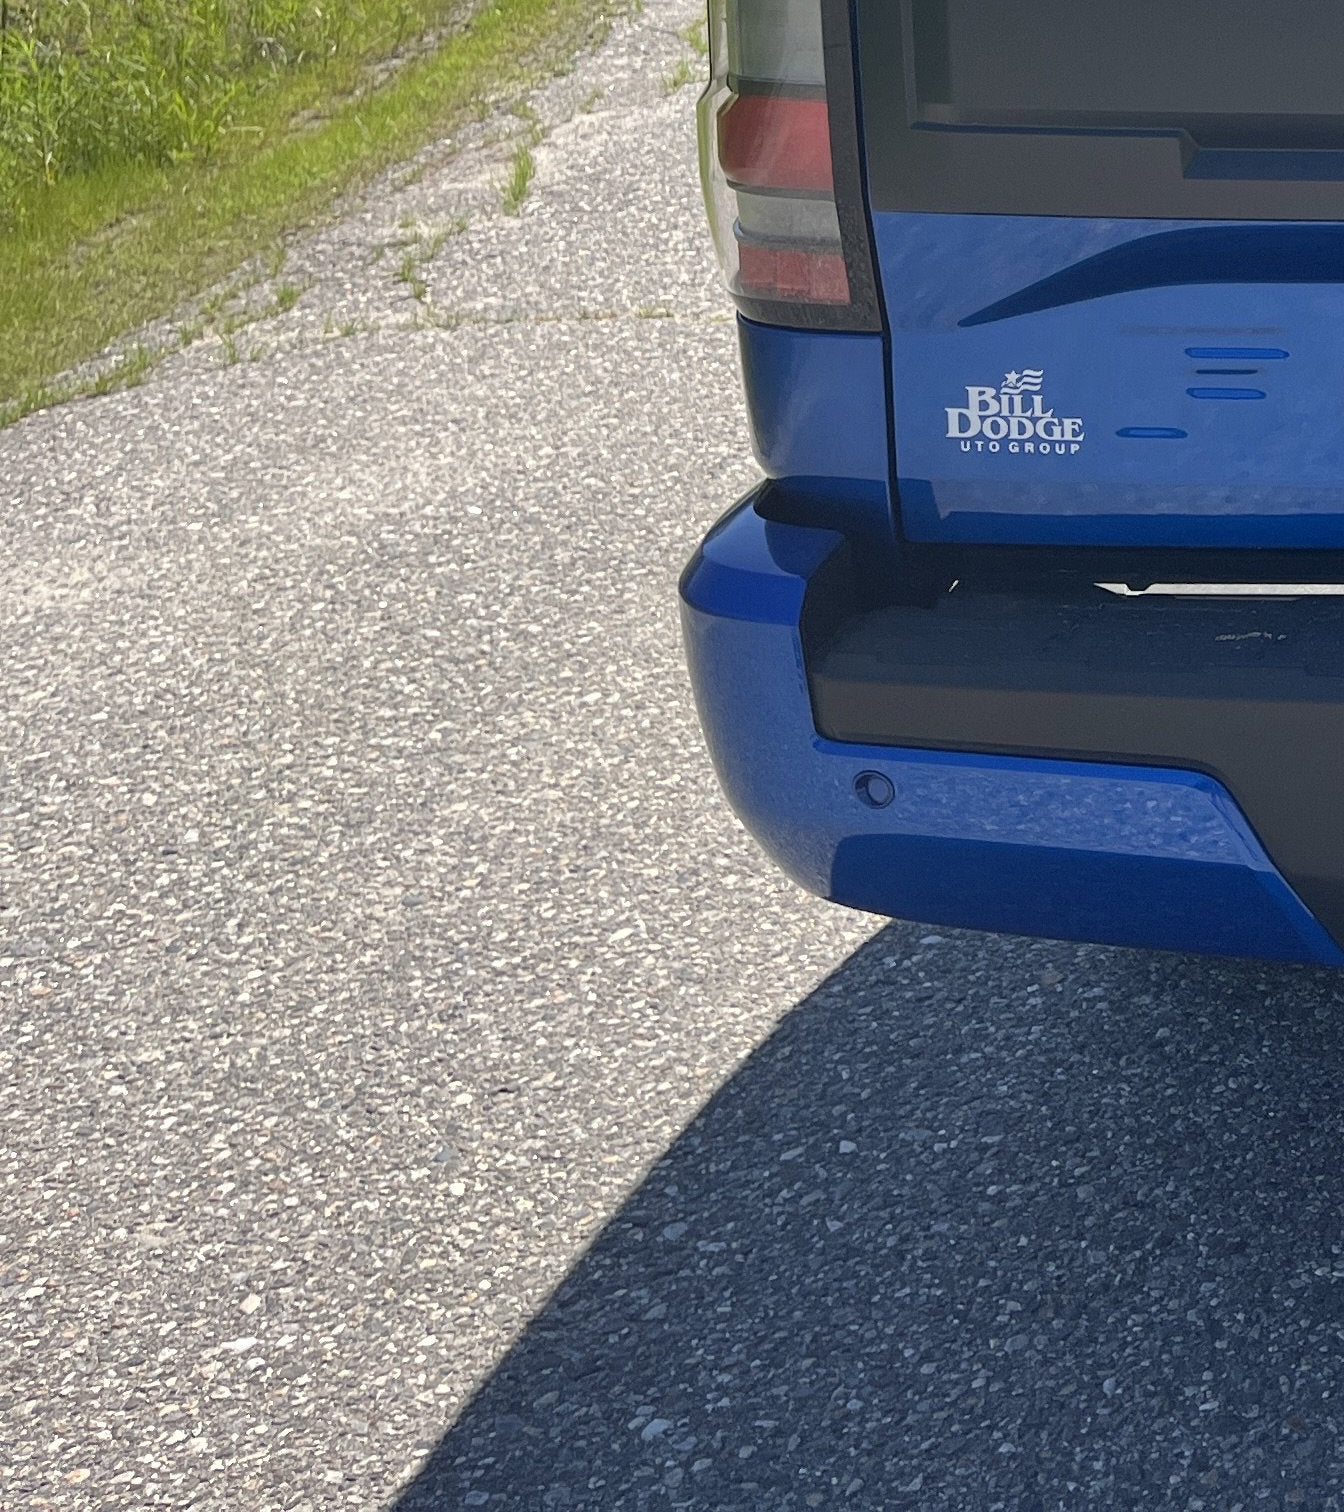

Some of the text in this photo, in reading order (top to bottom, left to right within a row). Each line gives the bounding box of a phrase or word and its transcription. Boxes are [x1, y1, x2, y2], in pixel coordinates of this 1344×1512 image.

[944, 407, 1085, 442] DODGE
[960, 441, 1081, 455] UTO GROUP
